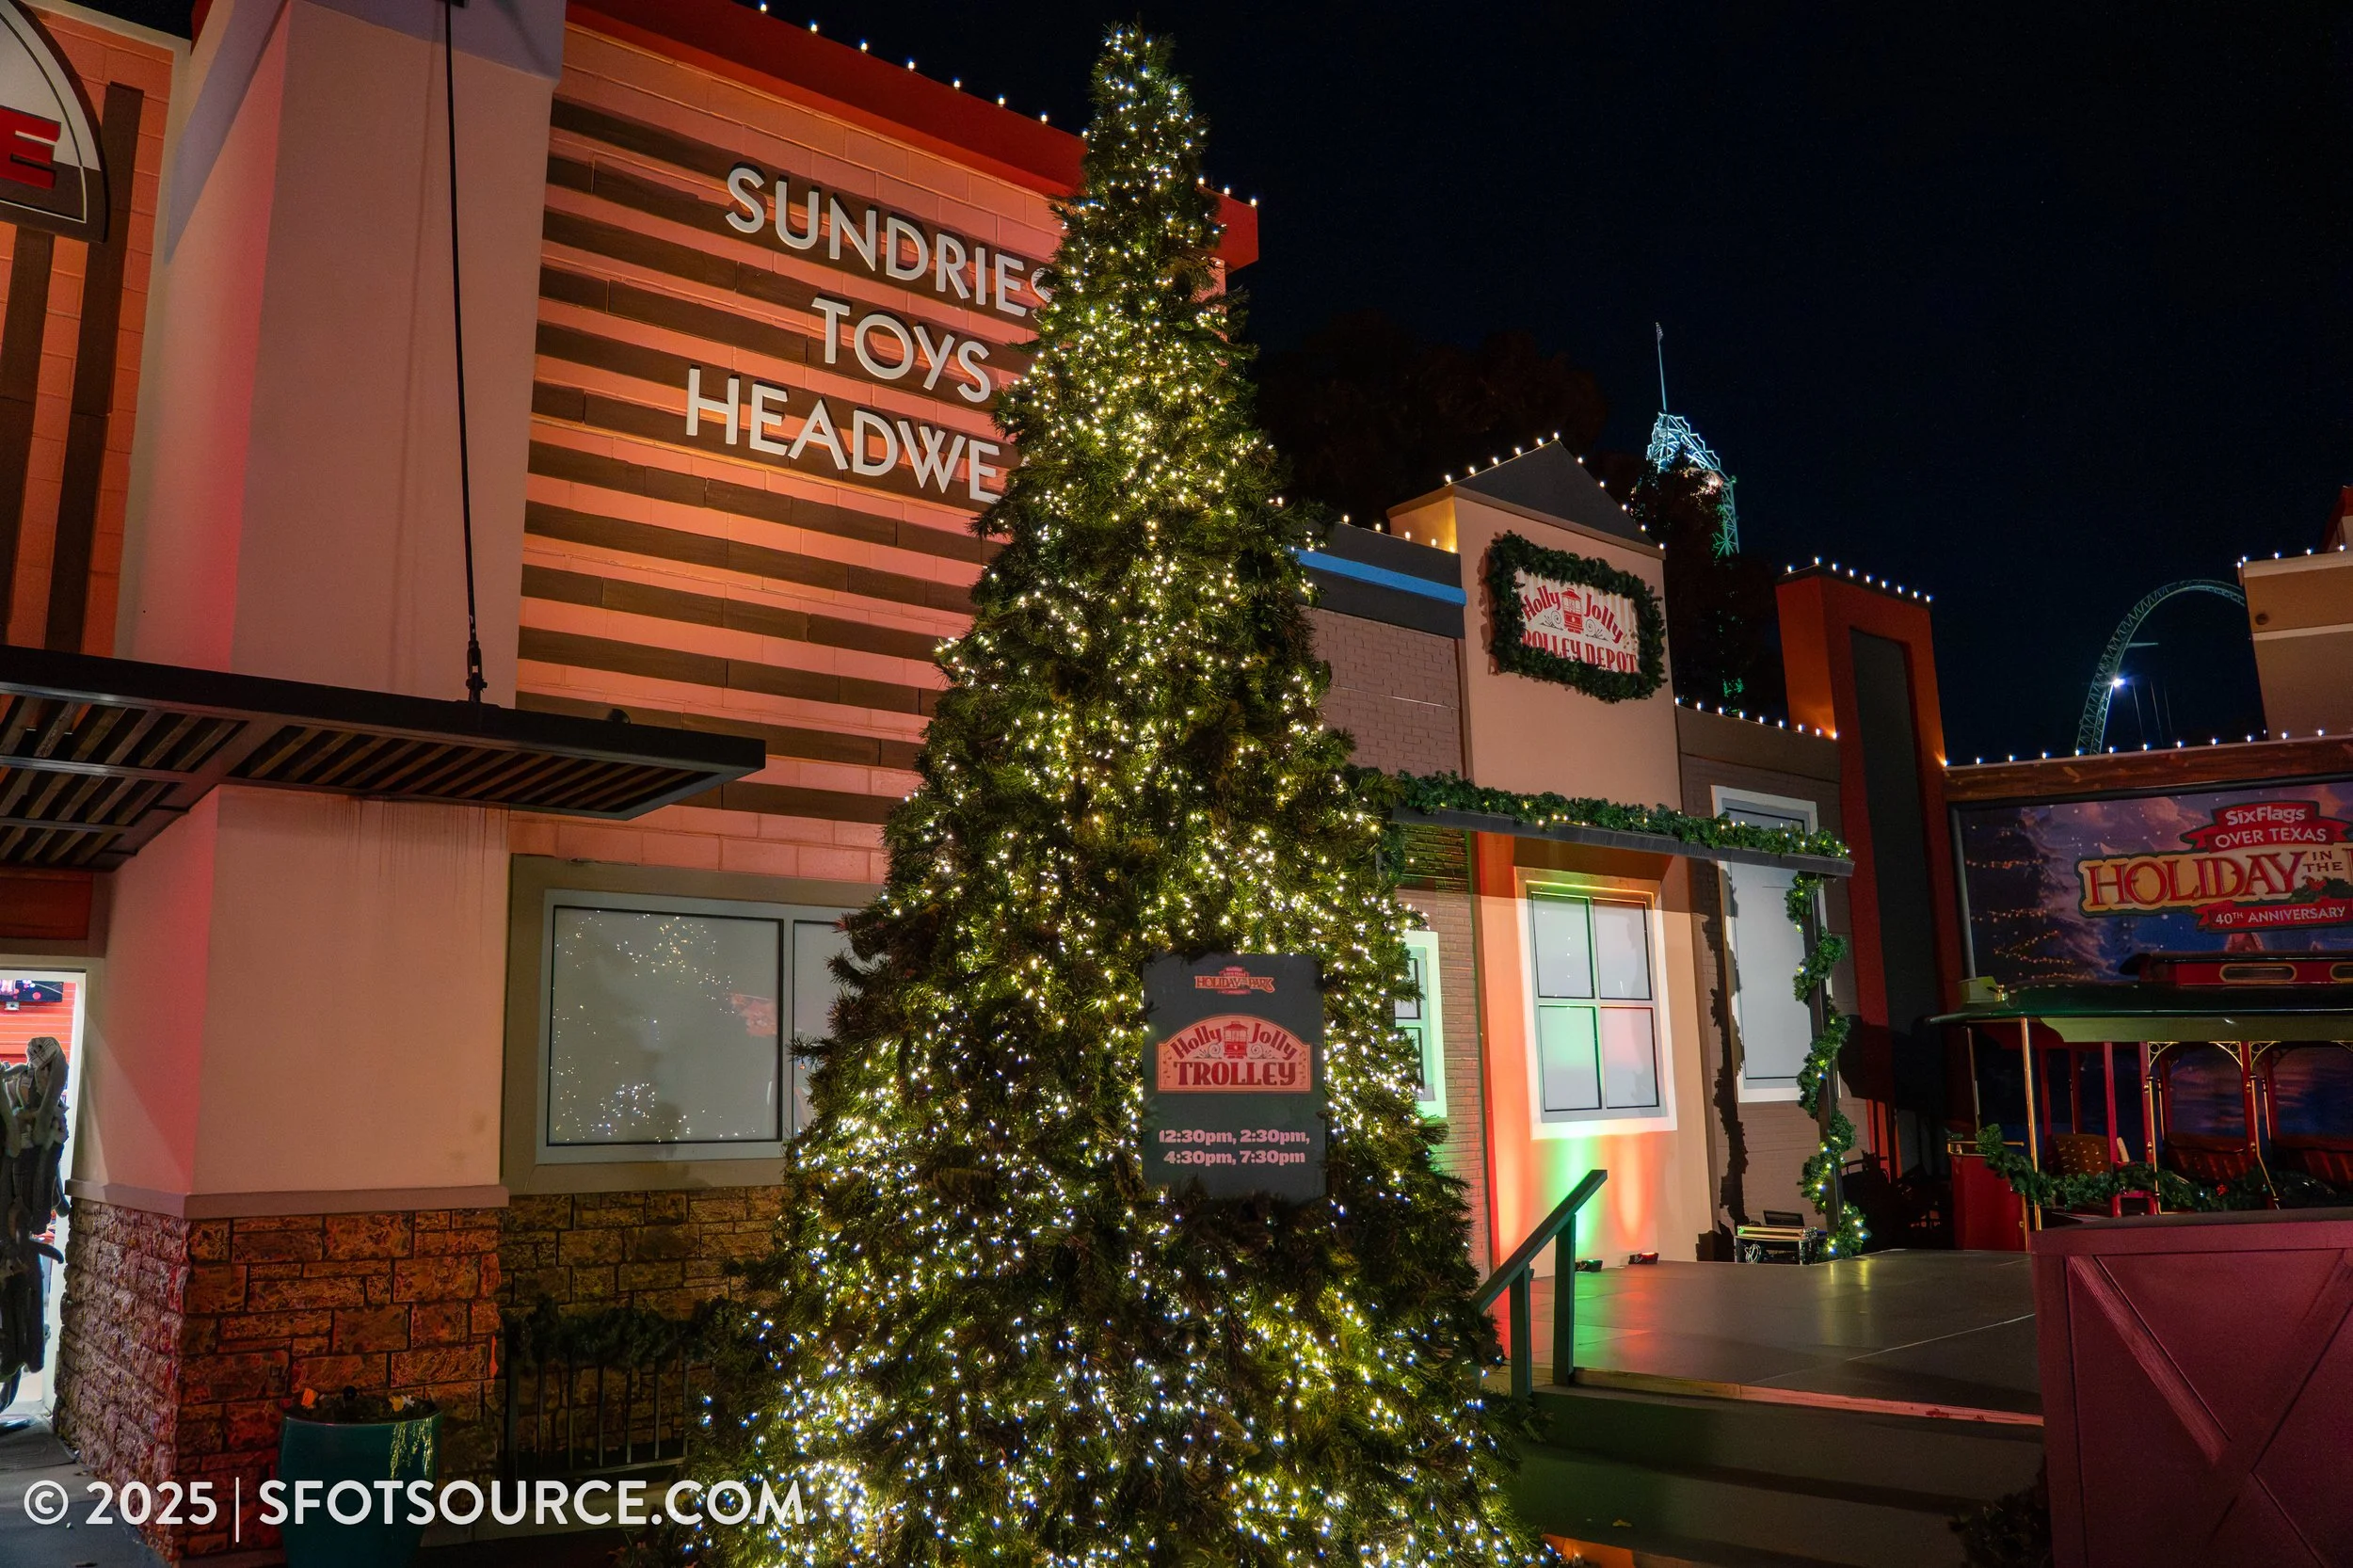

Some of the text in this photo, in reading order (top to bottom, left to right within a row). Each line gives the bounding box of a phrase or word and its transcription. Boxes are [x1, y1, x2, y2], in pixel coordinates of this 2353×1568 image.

[811, 297, 991, 403] TOYS
[686, 368, 1032, 503] HEADWE
[1522, 585, 1624, 644] Holly Jolly
[1522, 630, 1637, 673] ROLLEY DEPOT
[2215, 827, 2327, 847] OVER TEXAS
[2312, 850, 2333, 861] IN
[2303, 861, 2344, 873] THE
[2086, 851, 2308, 906] HOLIDAY
[2215, 906, 2346, 925] 40TH ANNIVERSARY
[1196, 977, 1241, 988] HOLIDAY
[1249, 977, 1274, 990] PARK
[1170, 1022, 1299, 1061] Holly Jolly
[1174, 1061, 1297, 1086] TROLLEY
[1159, 1129, 1311, 1146] 12:30pm, 2:30pm,
[1163, 1150, 1305, 1167] 4:30pm, 7:30pm
